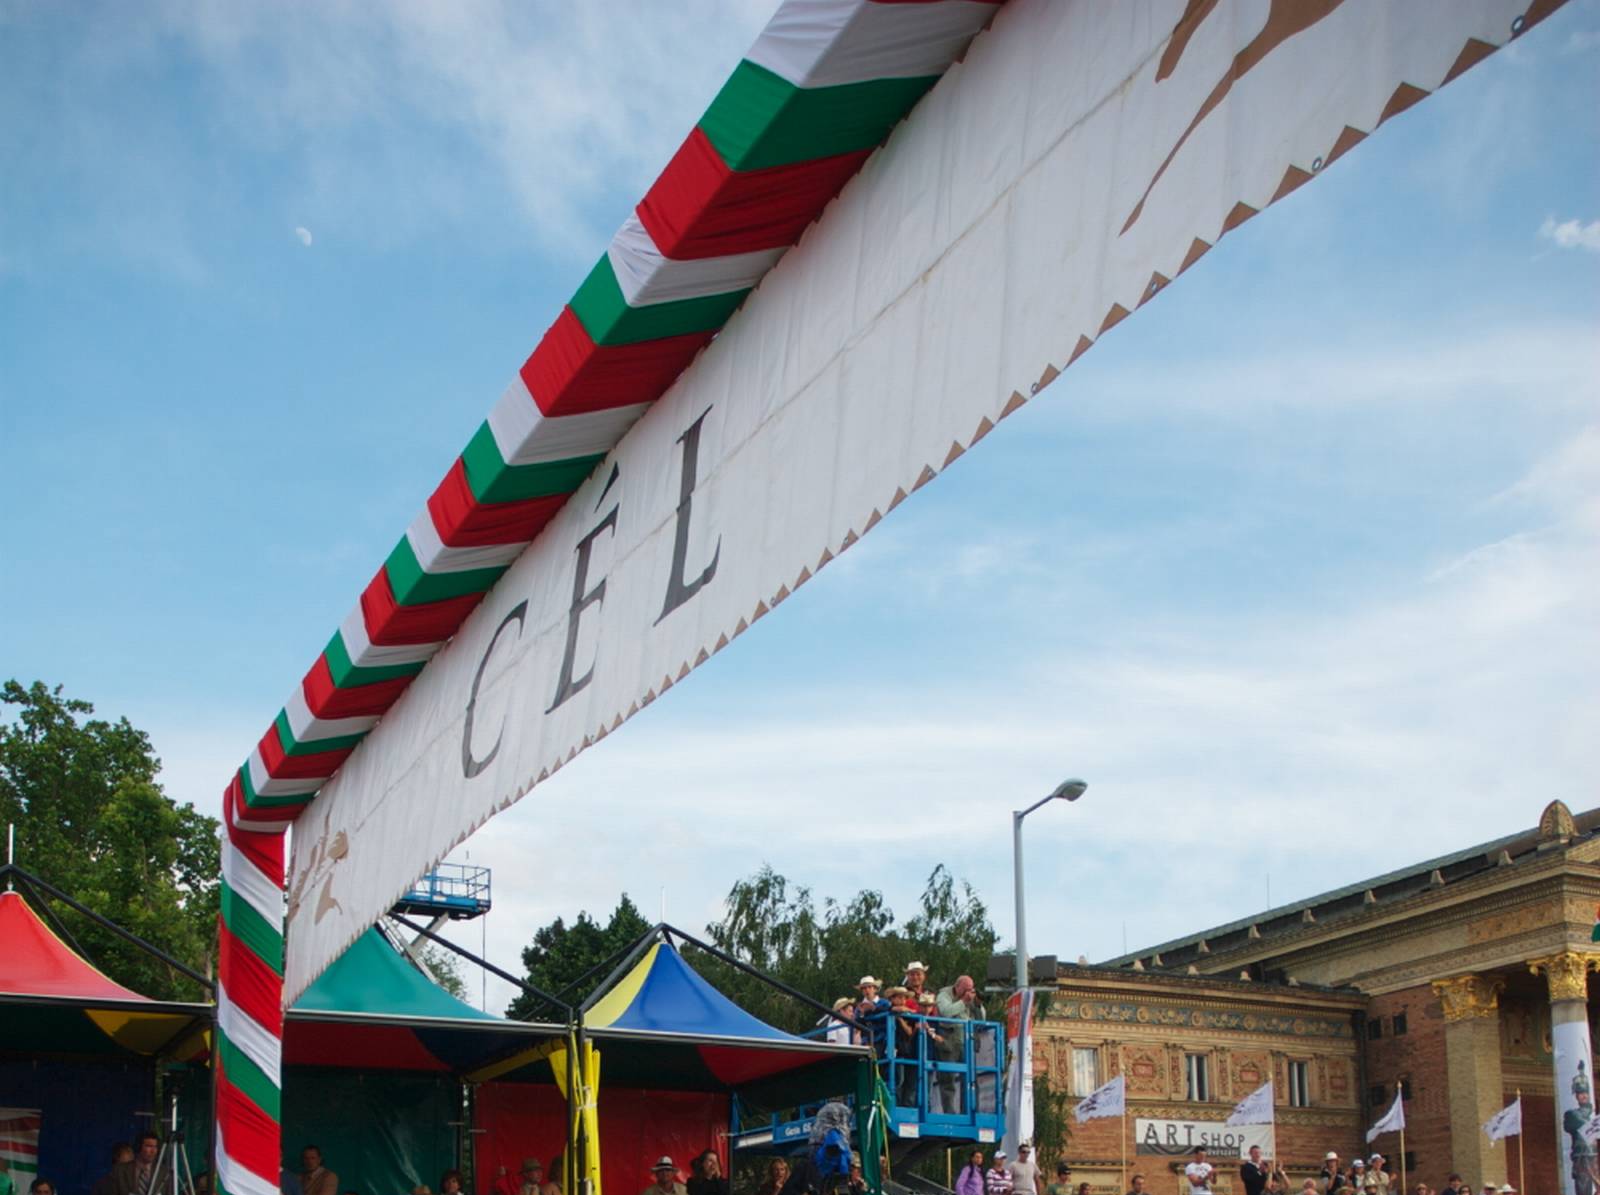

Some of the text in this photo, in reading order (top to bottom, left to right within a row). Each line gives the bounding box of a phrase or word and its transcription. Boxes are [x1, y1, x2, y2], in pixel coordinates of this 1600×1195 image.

[462, 404, 723, 779] CÉL
[1144, 1122, 1246, 1147] ART SHOP
